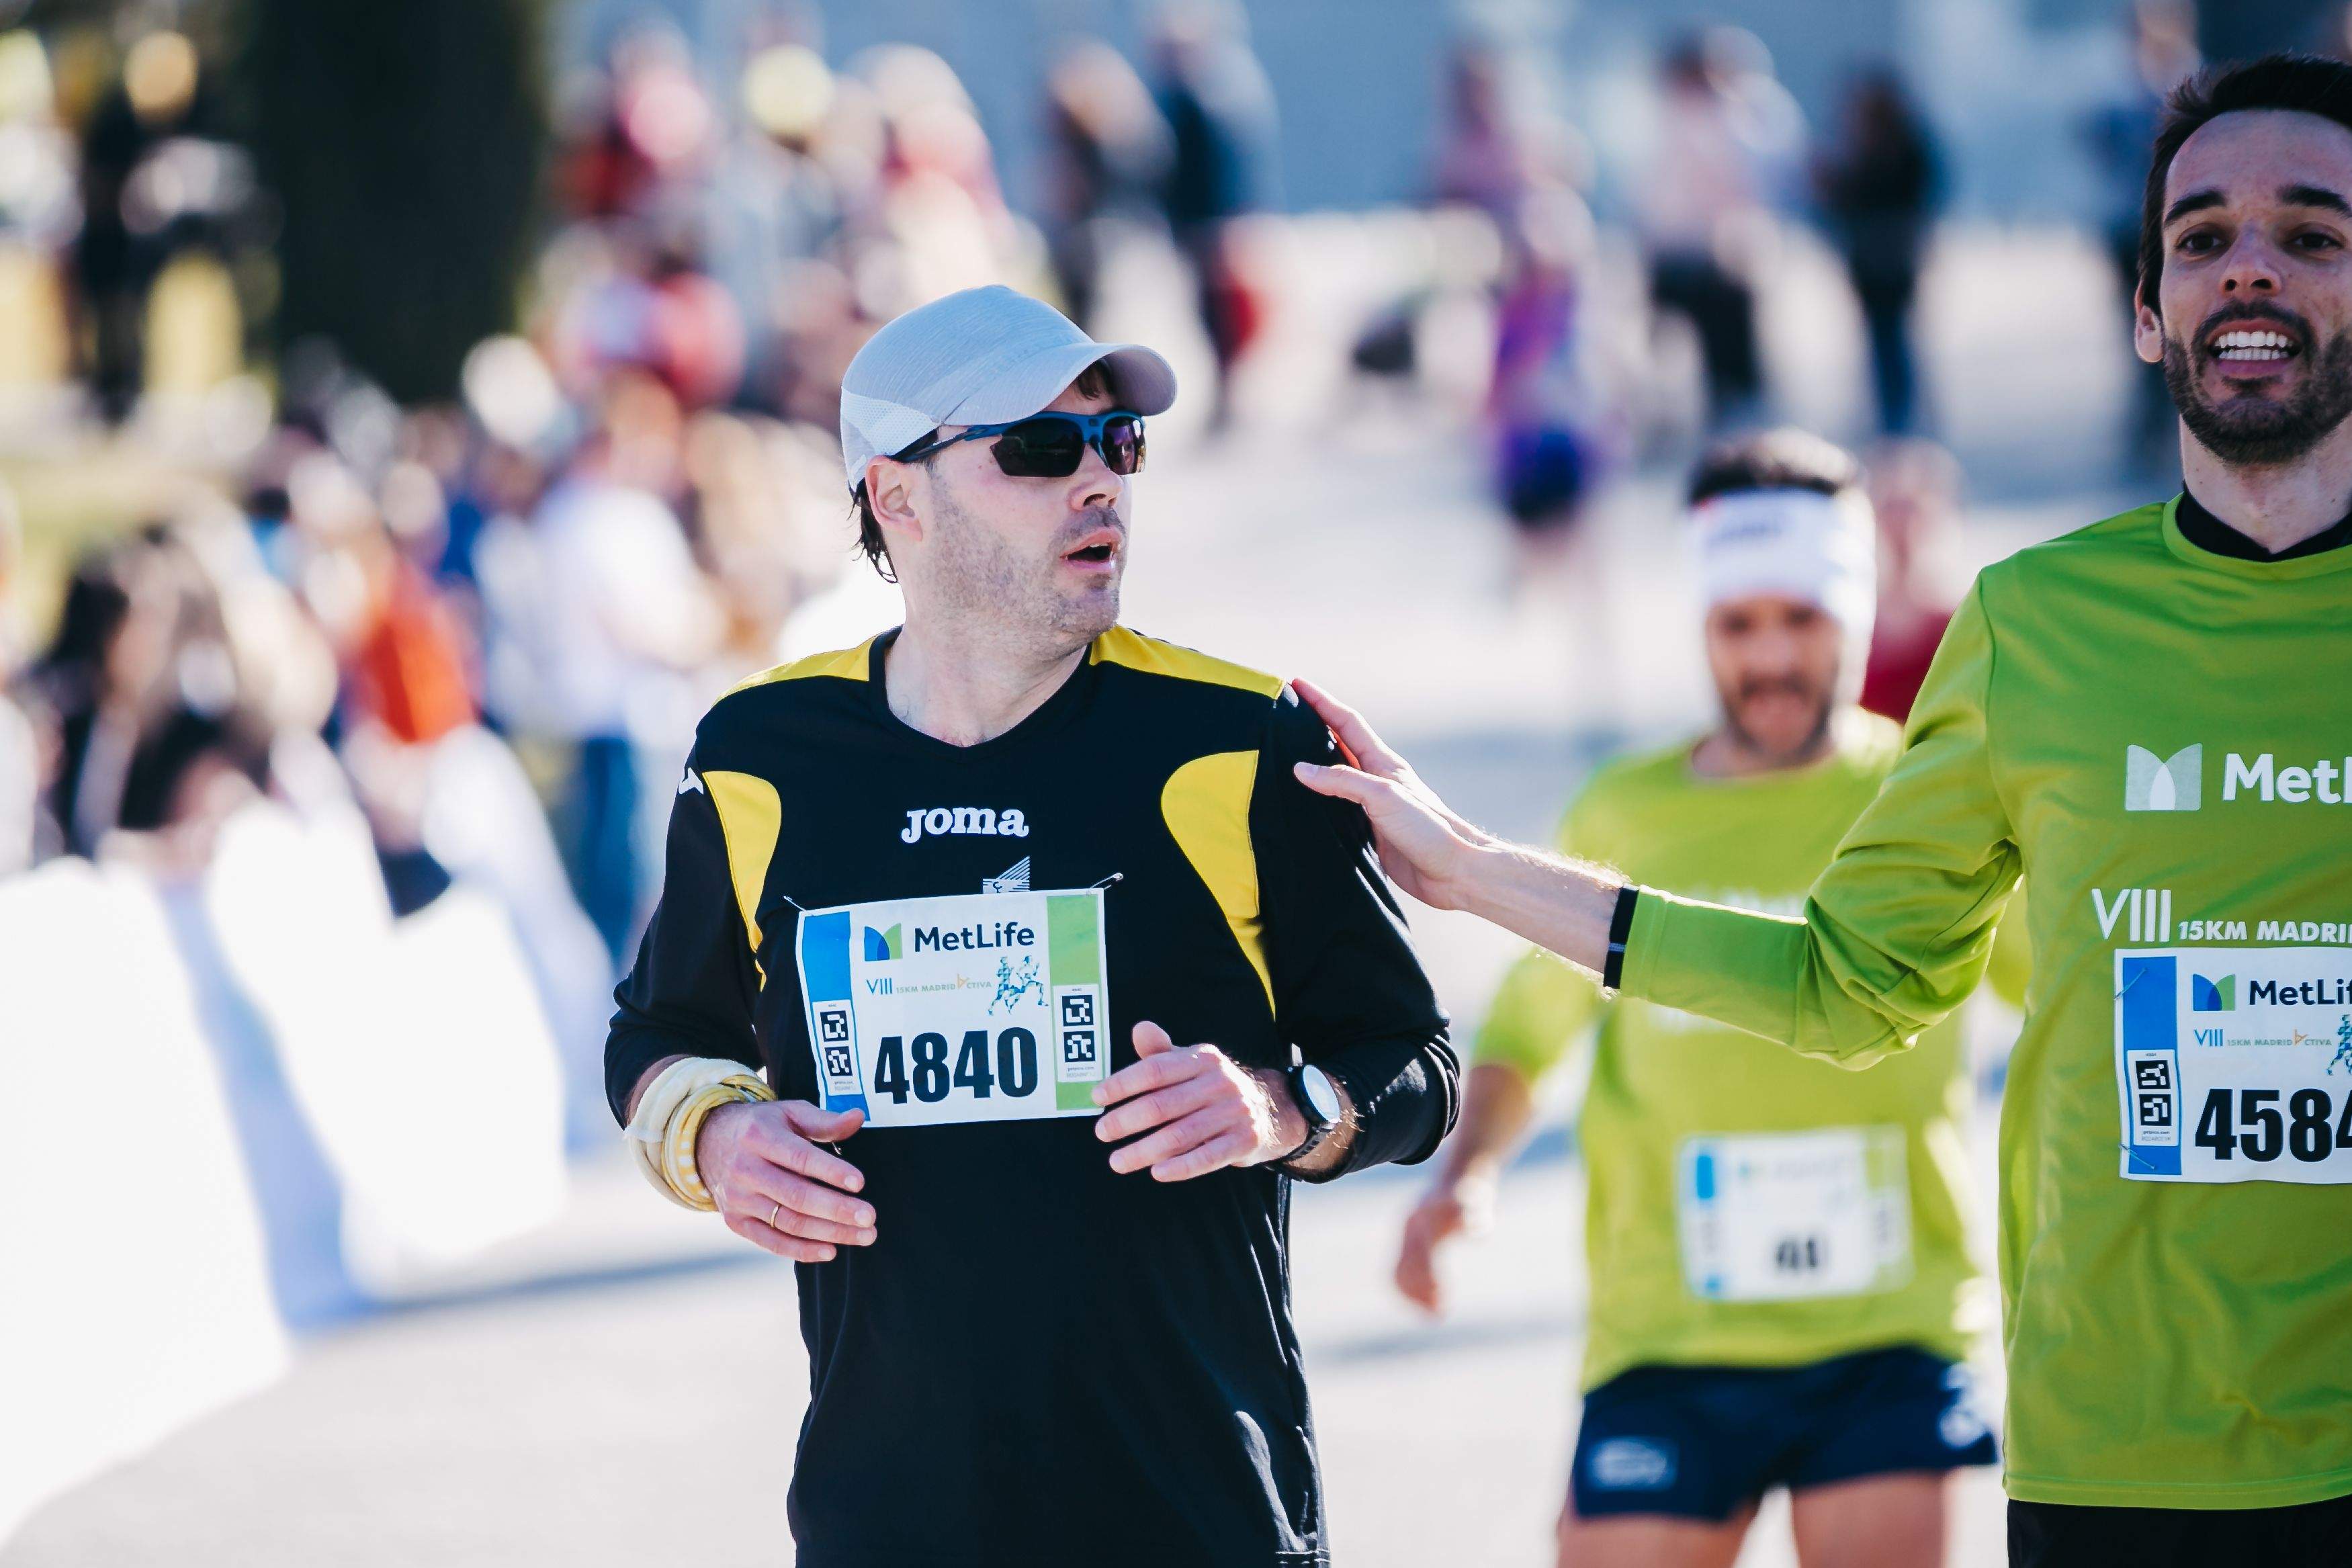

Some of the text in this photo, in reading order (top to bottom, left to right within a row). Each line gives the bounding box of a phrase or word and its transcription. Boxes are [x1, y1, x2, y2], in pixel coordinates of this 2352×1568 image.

[2091, 888, 2352, 943] VIII 15KM MADRI
[915, 922, 1035, 952] MetLife
[867, 977, 893, 994] VIII
[896, 986, 918, 994] 15KM
[922, 984, 955, 992] MADRID
[2193, 1029, 2224, 1047] VIII
[874, 1027, 1037, 1104] 4840
